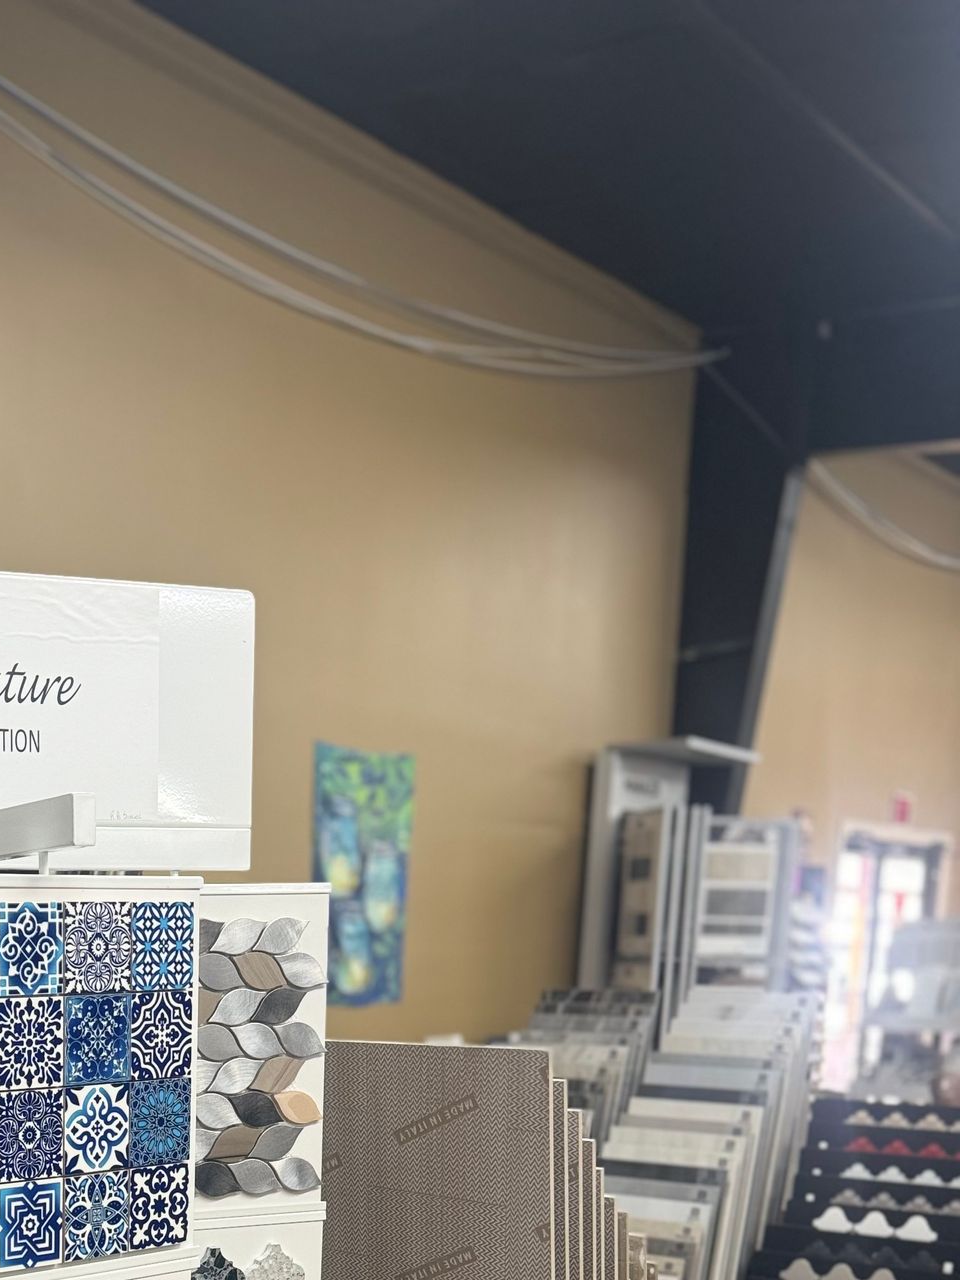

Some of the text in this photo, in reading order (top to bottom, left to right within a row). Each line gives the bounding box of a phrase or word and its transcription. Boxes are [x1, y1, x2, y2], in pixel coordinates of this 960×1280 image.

[400, 1099, 474, 1141] MADE IN ITALY
[428, 1263, 442, 1274] IN
[443, 1251, 472, 1269] MADE
